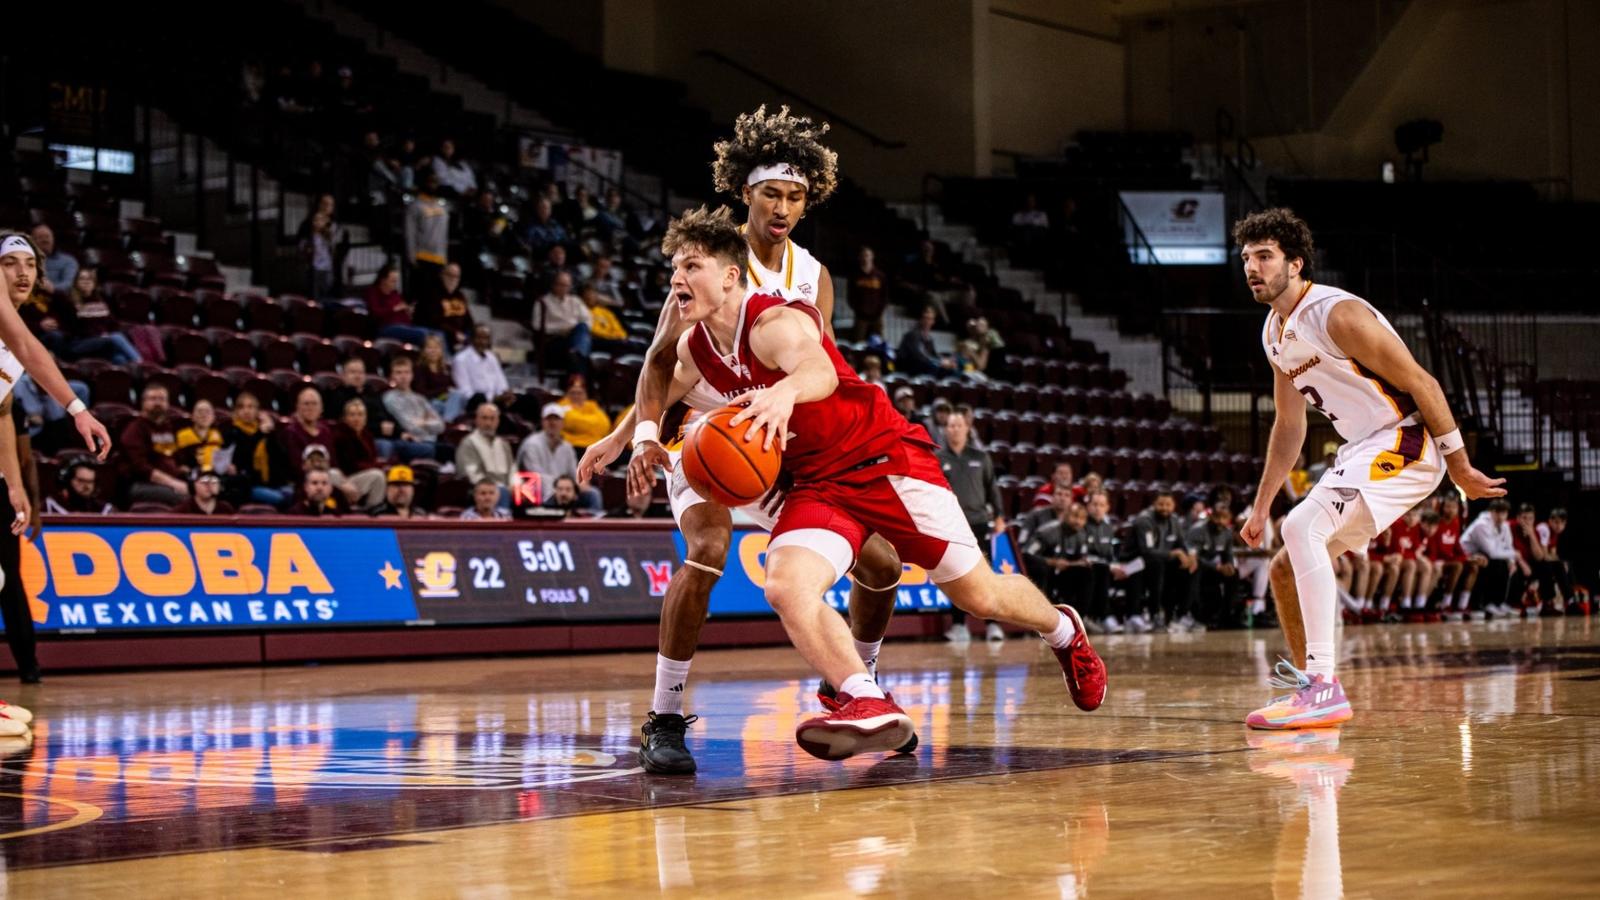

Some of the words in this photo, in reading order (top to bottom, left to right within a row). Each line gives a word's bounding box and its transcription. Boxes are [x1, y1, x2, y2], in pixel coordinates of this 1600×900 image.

[518, 540, 575, 572] 5:01
[469, 557, 504, 588] 22
[599, 557, 631, 587] 28
[540, 588, 577, 603] FOULS
[59, 602, 234, 625] MEXICAN
[247, 599, 336, 621] EATS
